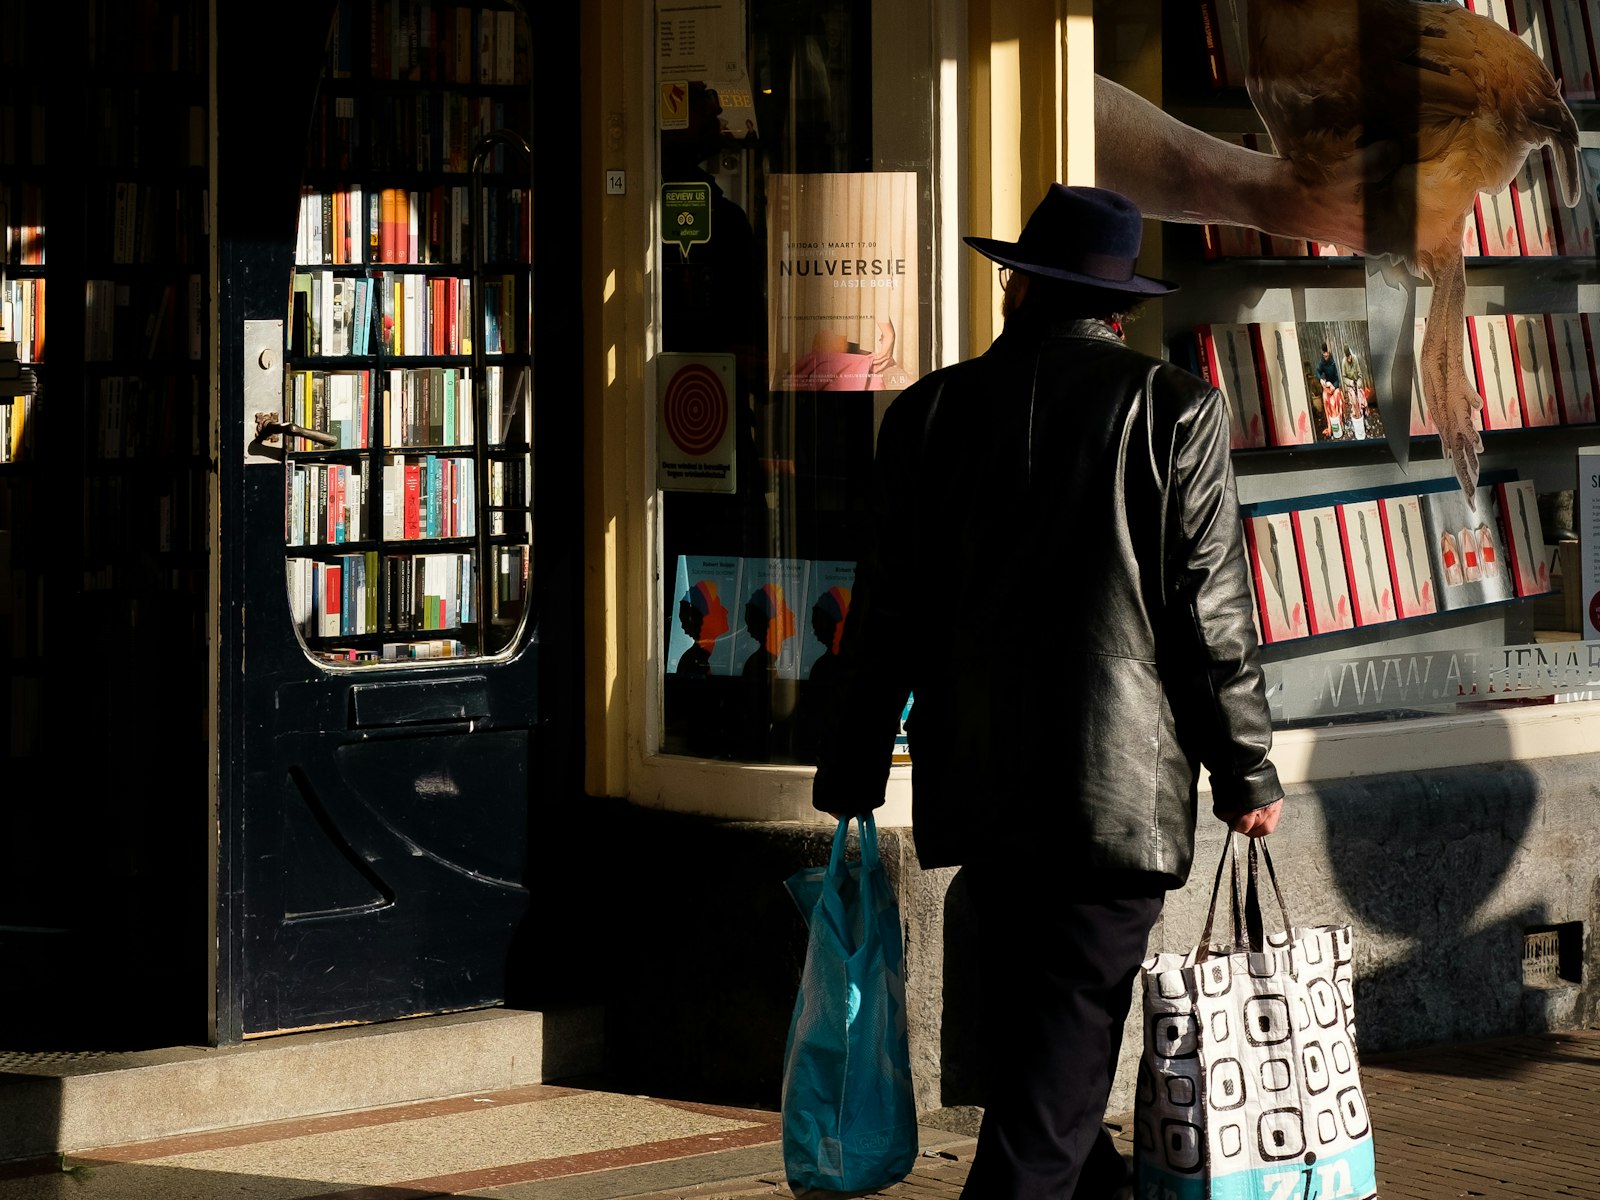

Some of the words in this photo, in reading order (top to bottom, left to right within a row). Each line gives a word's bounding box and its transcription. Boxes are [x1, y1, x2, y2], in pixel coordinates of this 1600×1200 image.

[609, 176, 623, 190] 14
[665, 192, 694, 201] REVIEW
[695, 191, 706, 201] US
[858, 241, 877, 249] 17.00
[780, 259, 906, 277] NULVERSIE
[833, 279, 867, 288] BASJE
[870, 279, 899, 288] BOER
[1263, 1151, 1355, 1200] zin
